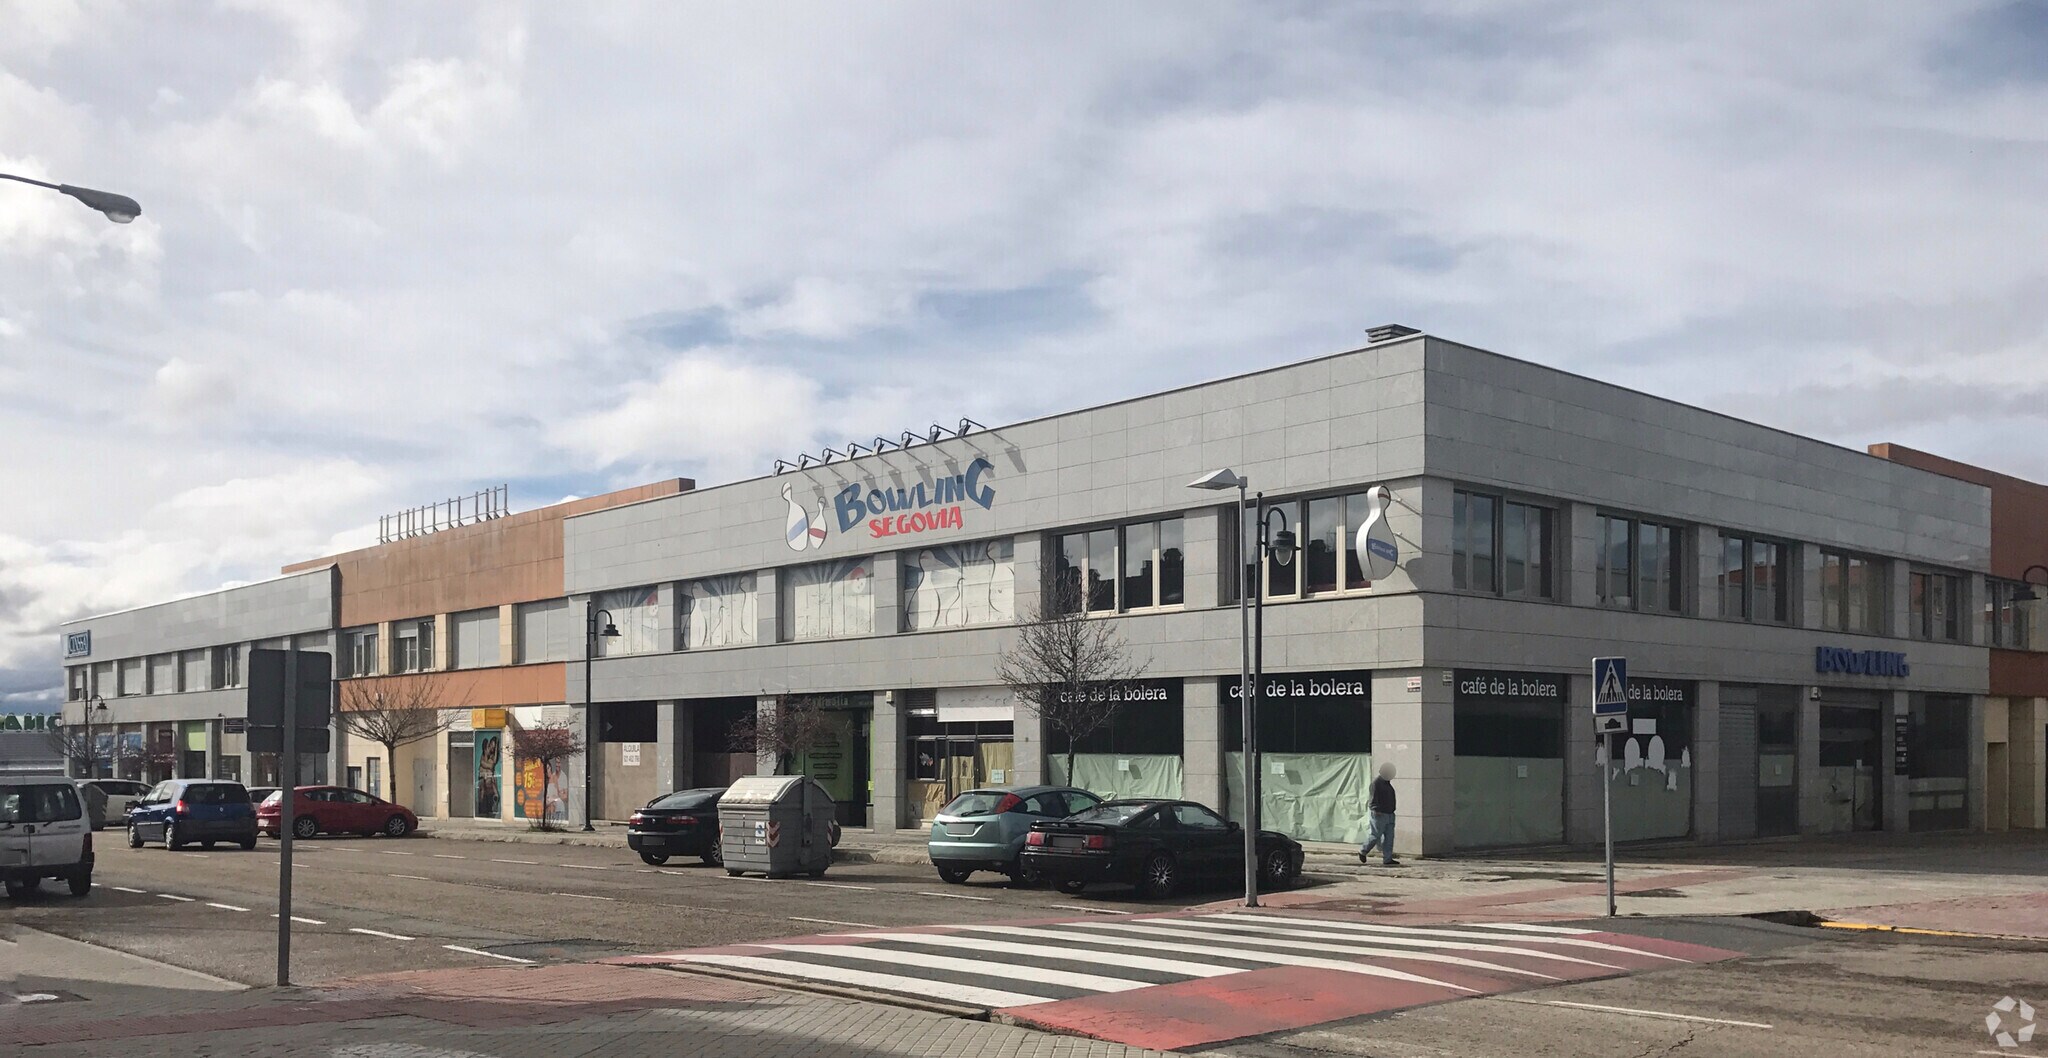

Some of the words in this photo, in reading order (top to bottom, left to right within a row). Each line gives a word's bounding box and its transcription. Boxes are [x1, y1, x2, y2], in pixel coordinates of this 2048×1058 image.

[834, 457, 996, 534] BOWLING
[869, 506, 963, 539] SEGOVIA
[1816, 646, 1910, 677] BOWLING
[1089, 687, 1106, 702] de
[1109, 685, 1121, 701] la
[1123, 684, 1168, 701] bolera
[1266, 680, 1287, 698] de
[1290, 679, 1306, 697] la
[1309, 678, 1364, 697] bolera
[1460, 676, 1487, 695] café
[1489, 677, 1506, 695] de
[1507, 678, 1519, 696] la
[1521, 678, 1558, 697] bolera
[1628, 683, 1641, 700] de
[1642, 684, 1652, 700] la
[1653, 684, 1683, 701] bolera
